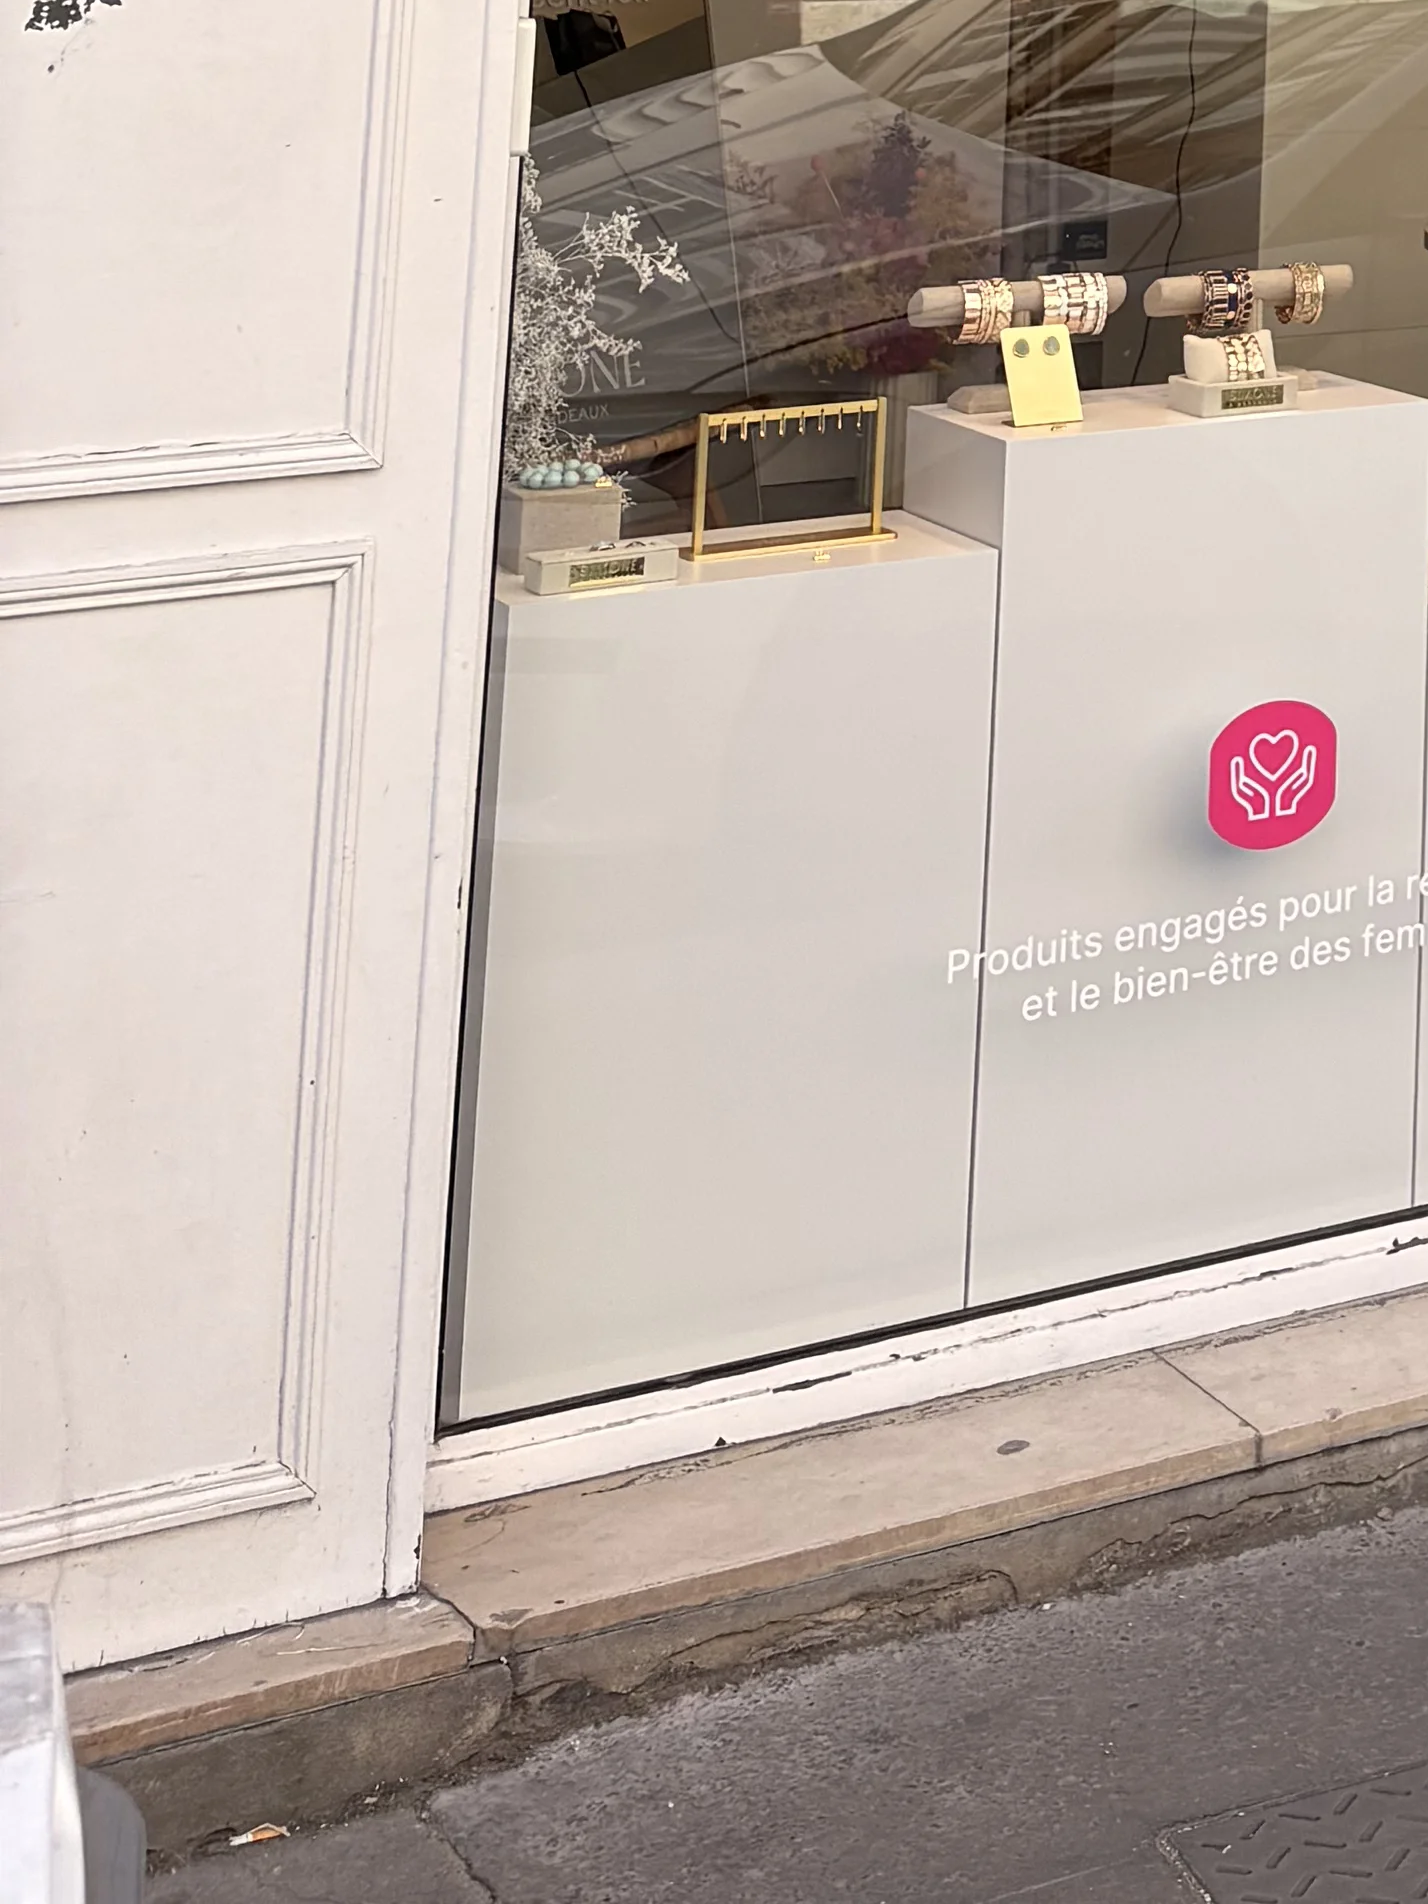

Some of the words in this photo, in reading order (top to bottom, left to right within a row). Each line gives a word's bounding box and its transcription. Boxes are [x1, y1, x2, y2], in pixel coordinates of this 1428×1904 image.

[946, 927, 1103, 984] Produits
[1113, 896, 1267, 954] engagés
[1278, 882, 1356, 931] pour
[1367, 874, 1395, 907] la
[1020, 989, 1058, 1022] et
[1070, 978, 1101, 1014] le
[1112, 948, 1279, 1006] bien-être
[1289, 936, 1352, 977] des
